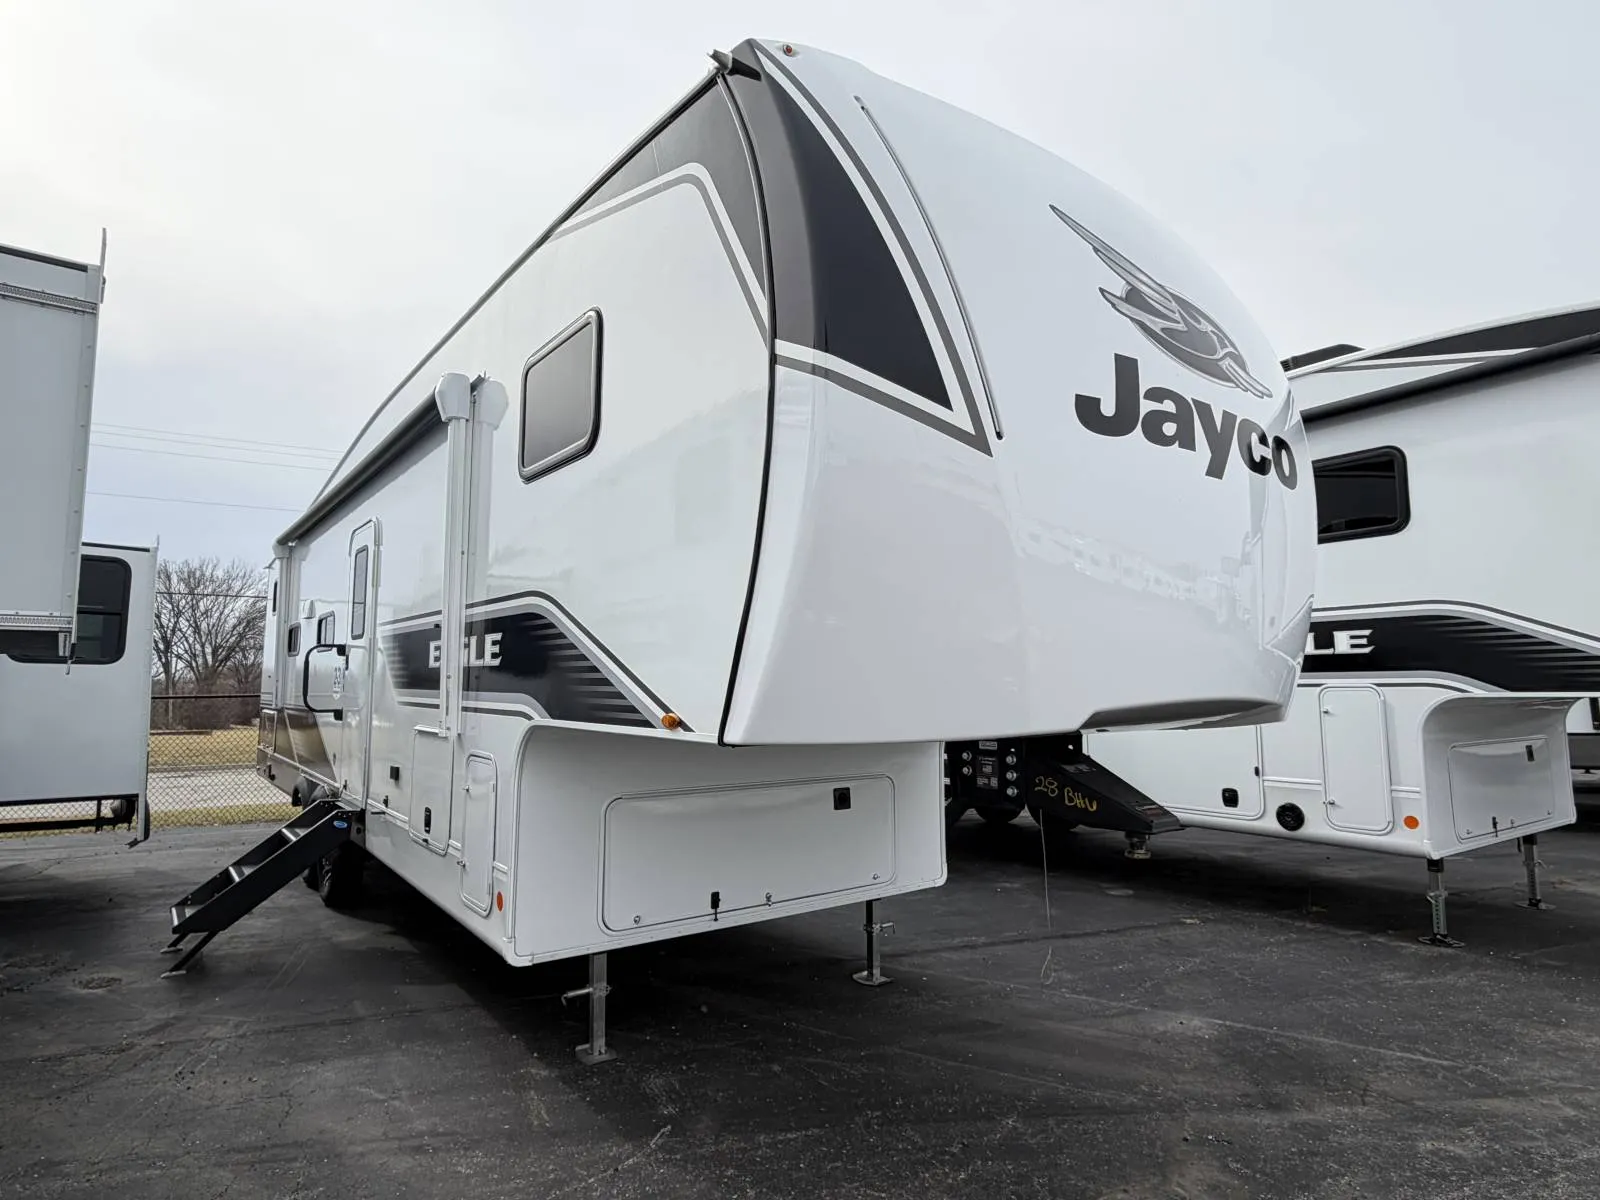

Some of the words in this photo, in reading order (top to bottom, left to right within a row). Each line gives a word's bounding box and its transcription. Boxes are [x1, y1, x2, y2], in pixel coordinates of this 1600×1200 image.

[1074, 353, 1298, 490] Jayco
[429, 632, 503, 668] ELE
[1304, 629, 1376, 655] LE
[1034, 775, 1059, 797] 28
